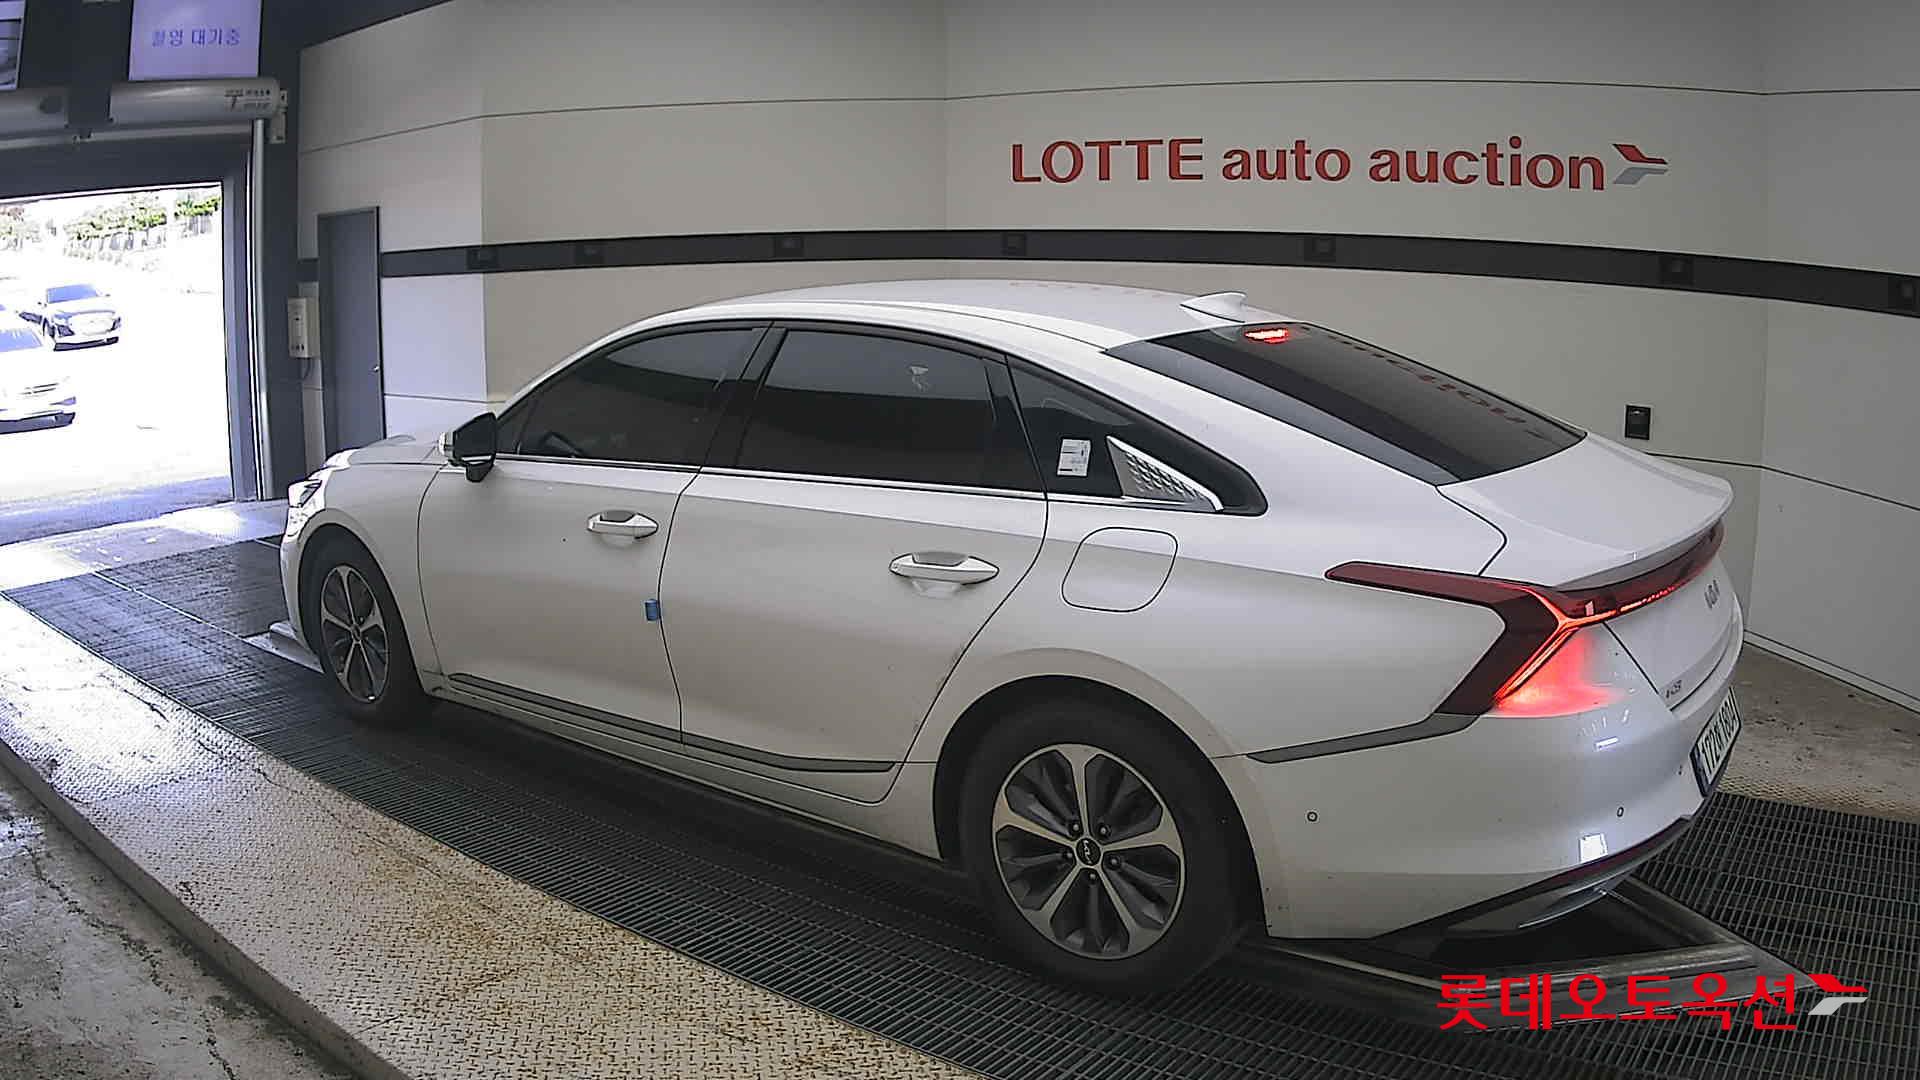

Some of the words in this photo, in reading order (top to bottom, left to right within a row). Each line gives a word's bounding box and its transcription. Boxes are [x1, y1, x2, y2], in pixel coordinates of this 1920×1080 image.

[1011, 137, 1203, 184] LOTTE
[1221, 140, 1352, 181] auto
[1369, 137, 1606, 192] auction
